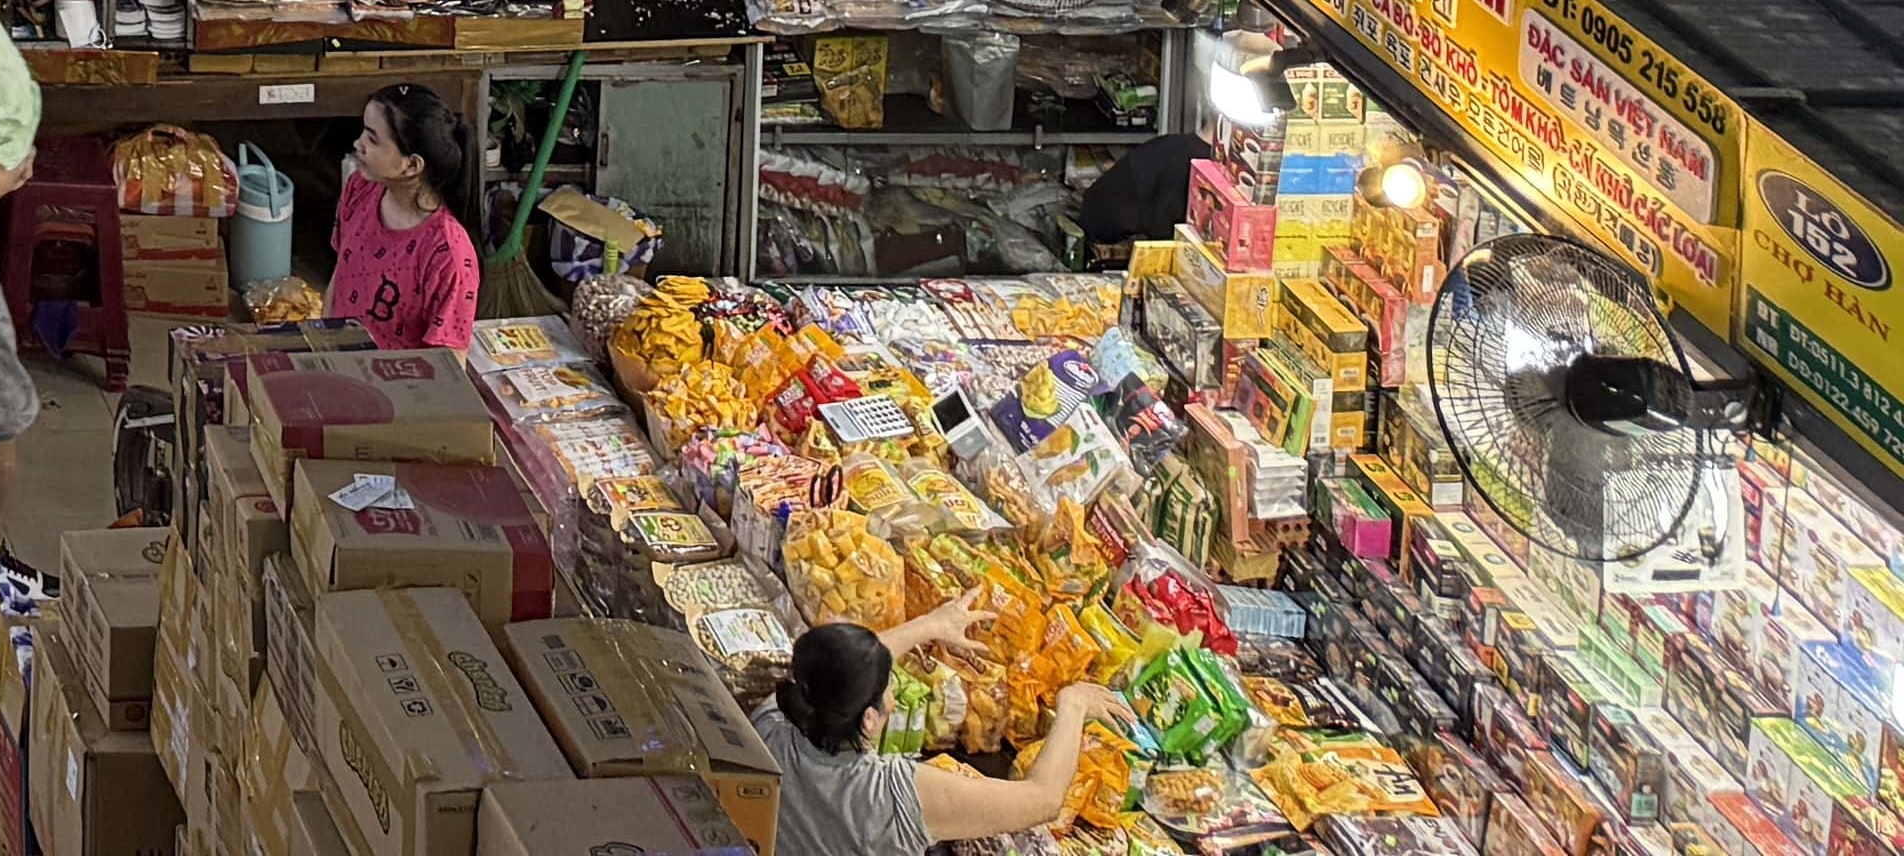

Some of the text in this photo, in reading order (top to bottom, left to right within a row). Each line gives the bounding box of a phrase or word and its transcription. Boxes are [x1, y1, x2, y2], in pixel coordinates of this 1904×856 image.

[1528, 24, 1708, 181] ĐẶC SẢN VIỆT NAM
[1581, 6, 1633, 63] 0905
[1640, 51, 1678, 98] 215
[1683, 81, 1726, 135] 558
[1754, 229, 1891, 342] CHỢ HÀN
[1788, 190, 1857, 277] LÔ 152
